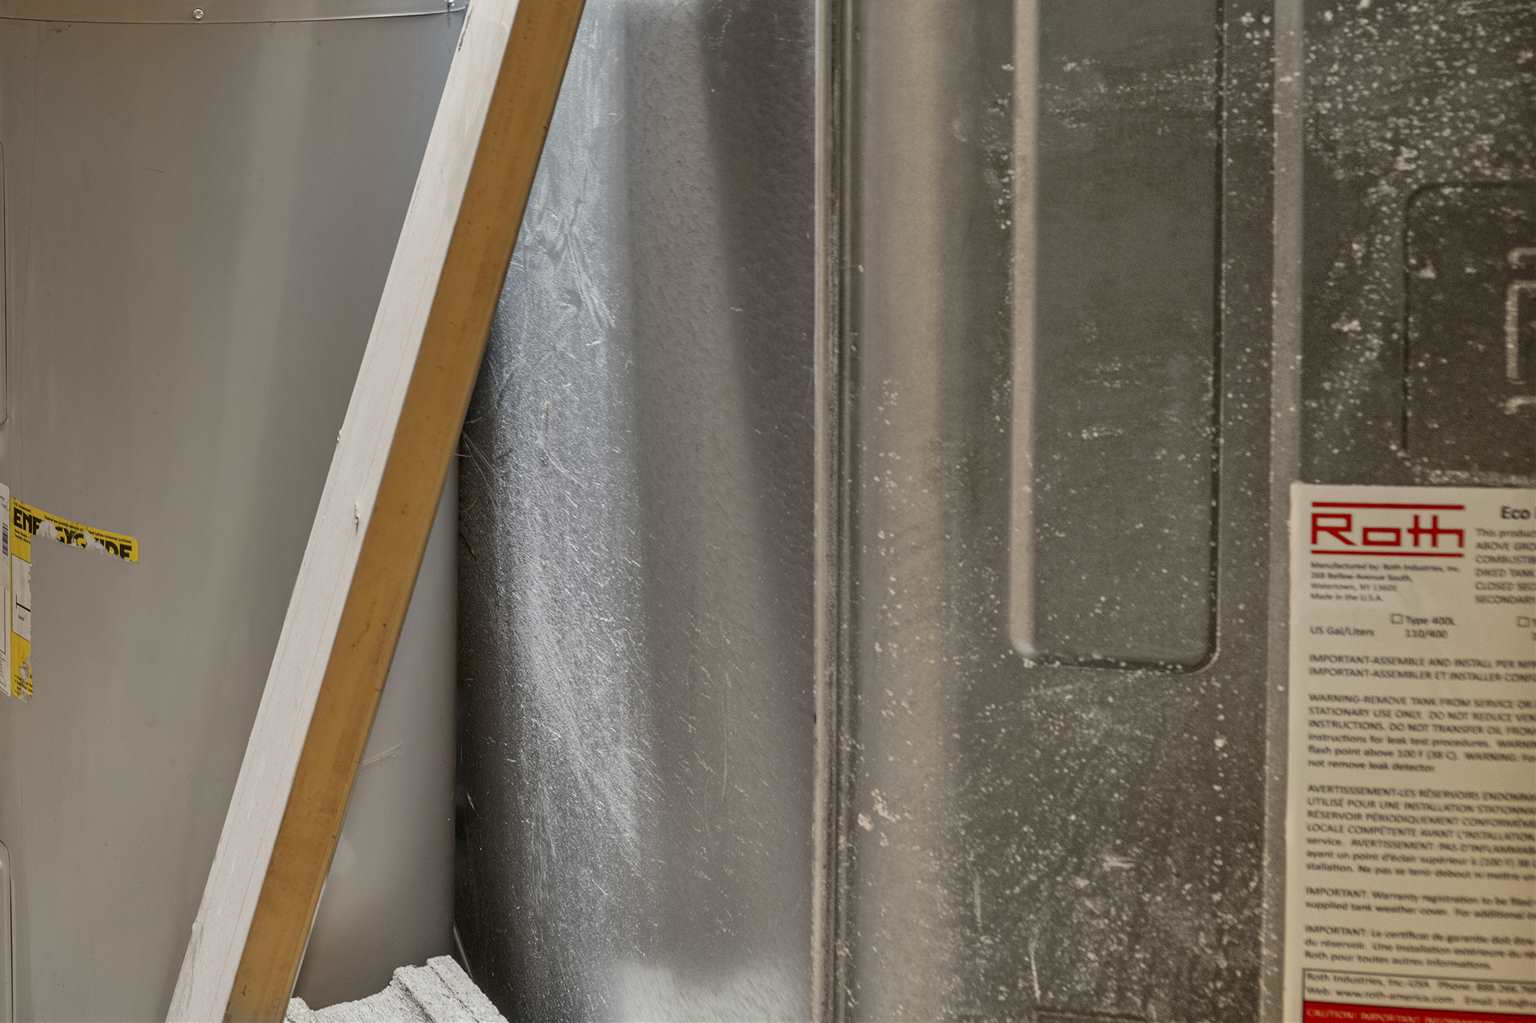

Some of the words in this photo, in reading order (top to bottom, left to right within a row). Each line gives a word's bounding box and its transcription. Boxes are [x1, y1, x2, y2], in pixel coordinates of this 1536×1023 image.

[1501, 506, 1531, 520] Eco
[1311, 513, 1464, 548] Roth
[1475, 581, 1514, 591] CLOSED
[1311, 592, 1333, 601] Made
[1405, 616, 1429, 626] Type
[1429, 657, 1451, 667] AND
[1455, 658, 1492, 668] INSTALL
[1439, 697, 1471, 707] FROM
[1308, 707, 1368, 718] STATIONARY
[1373, 709, 1391, 718] USE
[1449, 711, 1468, 721] NOT
[1473, 712, 1511, 722] REDUCE
[1408, 722, 1430, 732] NOT
[1432, 723, 1483, 734] TRANSFER
[1308, 733, 1366, 744] instructions
[1388, 736, 1406, 745] leak
[1335, 747, 1361, 757] point
[1364, 748, 1395, 758] above
[1328, 759, 1365, 770] remove
[1369, 761, 1389, 771] leak
[1348, 799, 1376, 809] POUR
[1380, 800, 1400, 810] UNE
[1404, 801, 1473, 814] INSTALLATION
[1306, 823, 1345, 834] LOCALE
[1353, 851, 1378, 861] point
[1372, 890, 1418, 901] Warranty
[1305, 900, 1348, 912] supplied
[1351, 903, 1372, 913] tank
[1376, 904, 1417, 915] weather
[1304, 950, 1328, 961] Roth
[1331, 952, 1354, 962] pour
[1306, 973, 1329, 984] Roth
